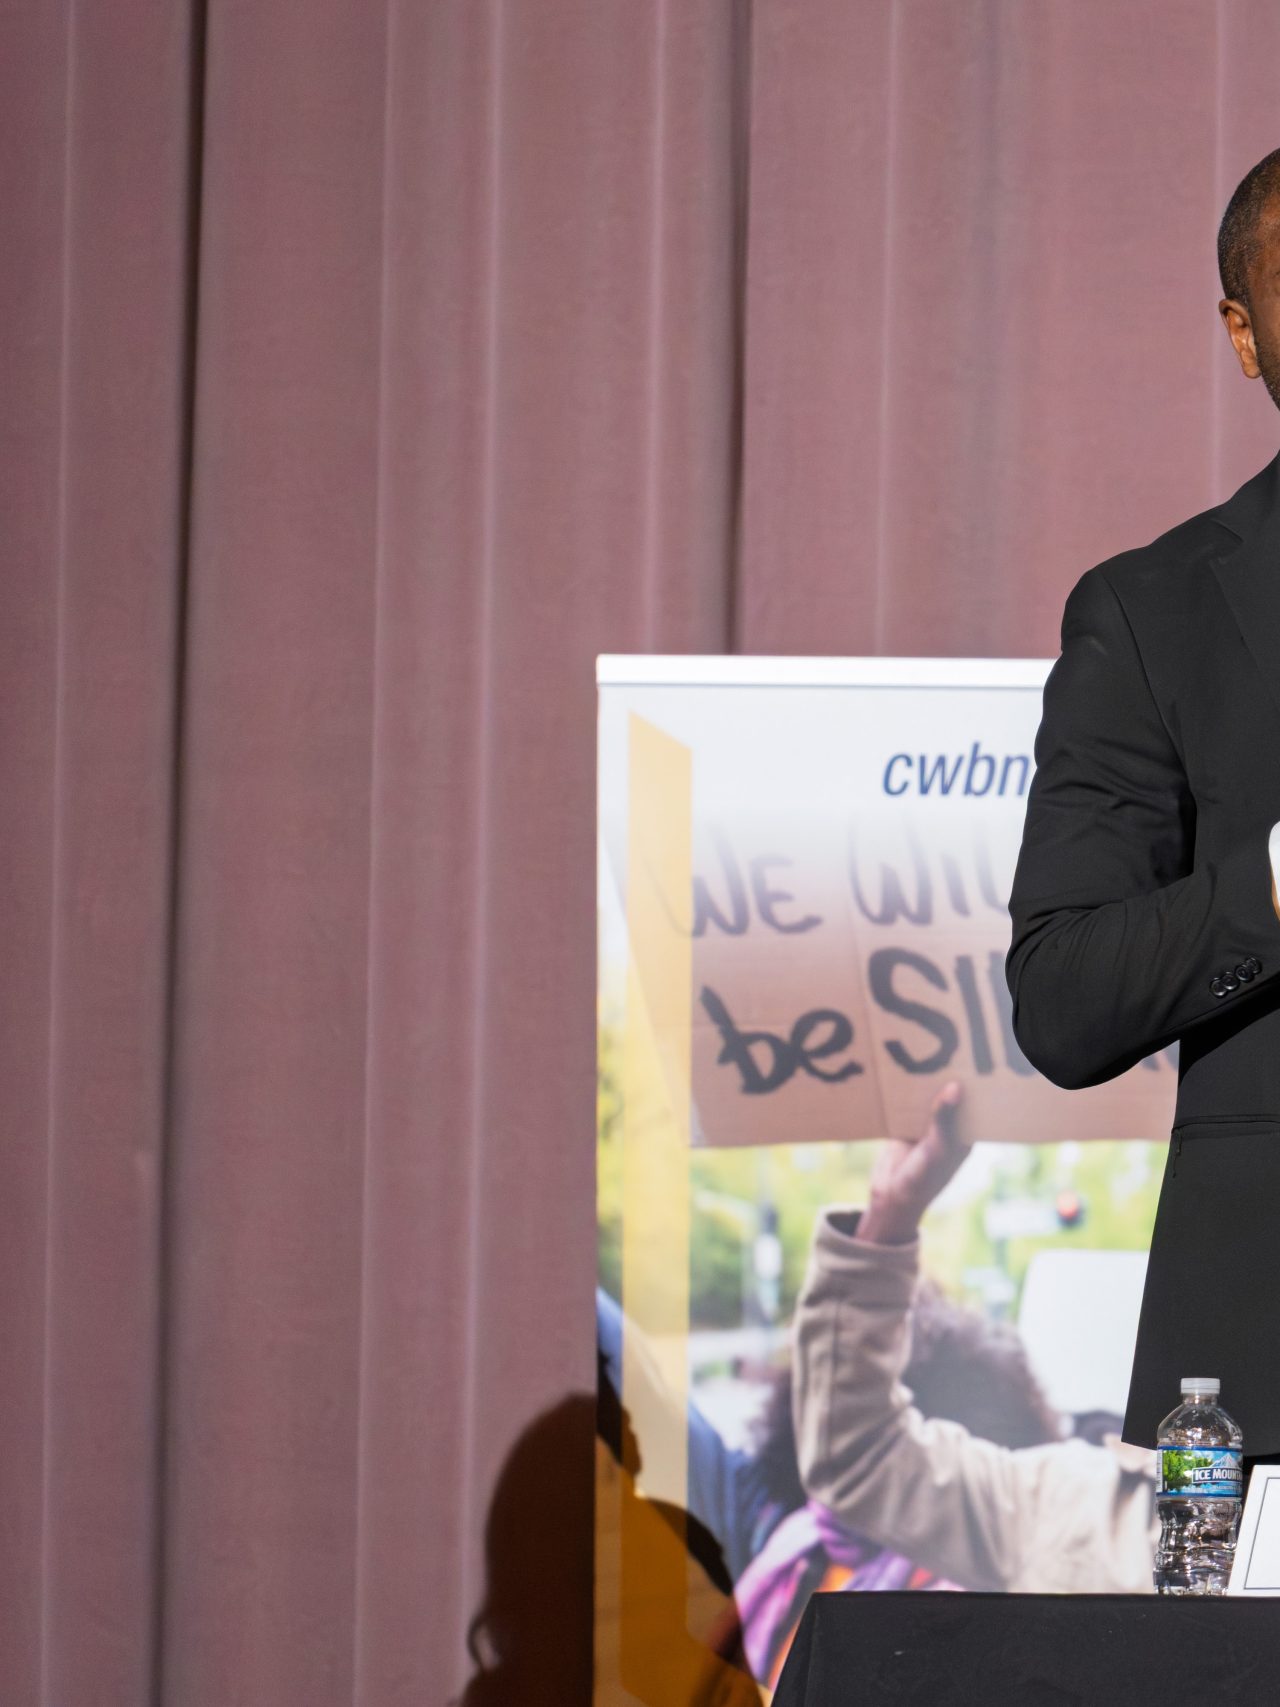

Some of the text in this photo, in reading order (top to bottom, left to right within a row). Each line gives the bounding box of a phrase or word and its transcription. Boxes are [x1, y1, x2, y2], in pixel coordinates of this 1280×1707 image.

[640, 822, 824, 938] WE
[699, 984, 864, 1095] be
[1194, 1469, 1212, 1481] ICE
